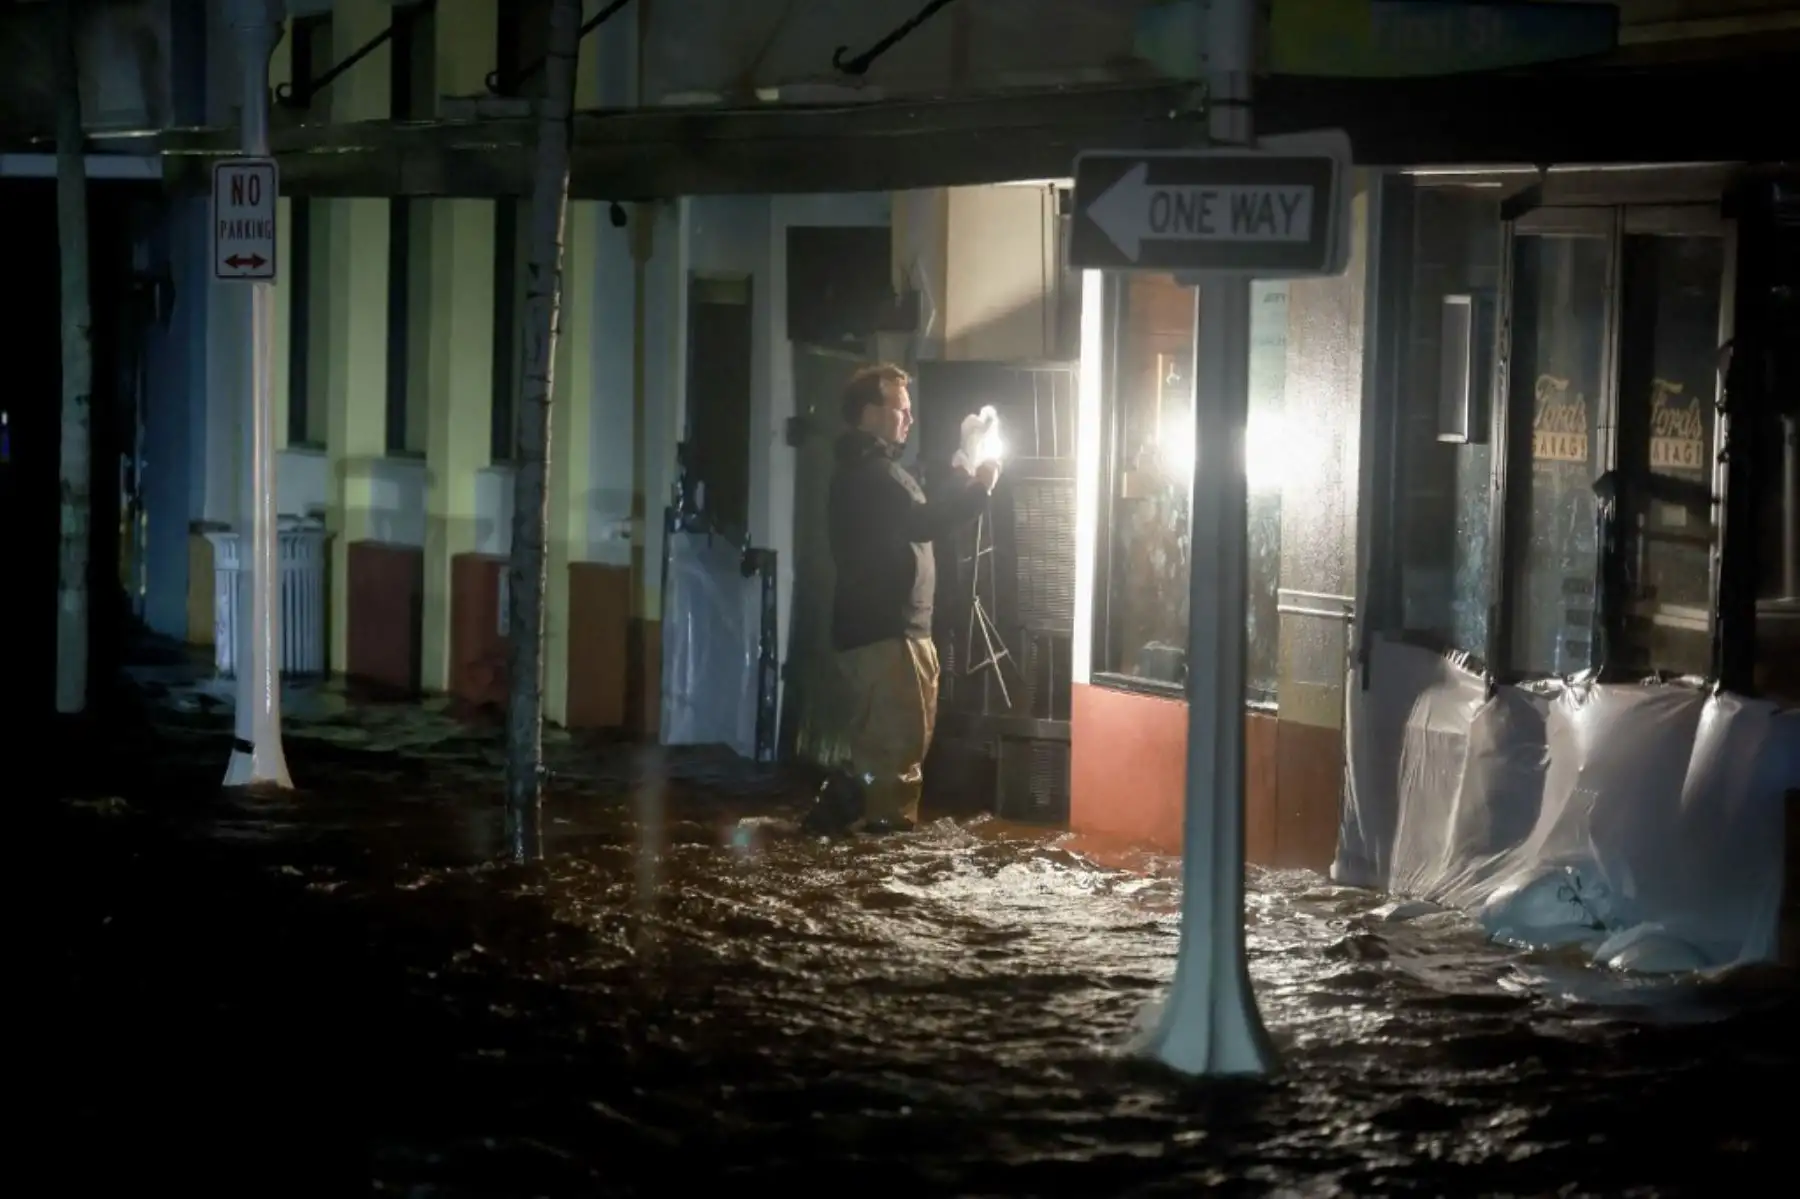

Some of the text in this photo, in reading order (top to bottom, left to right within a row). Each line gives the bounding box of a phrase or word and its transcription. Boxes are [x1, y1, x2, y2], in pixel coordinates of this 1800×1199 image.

[231, 174, 260, 206] NO
[1150, 191, 1303, 236] ONE WAY
[220, 220, 273, 240] PARKING
